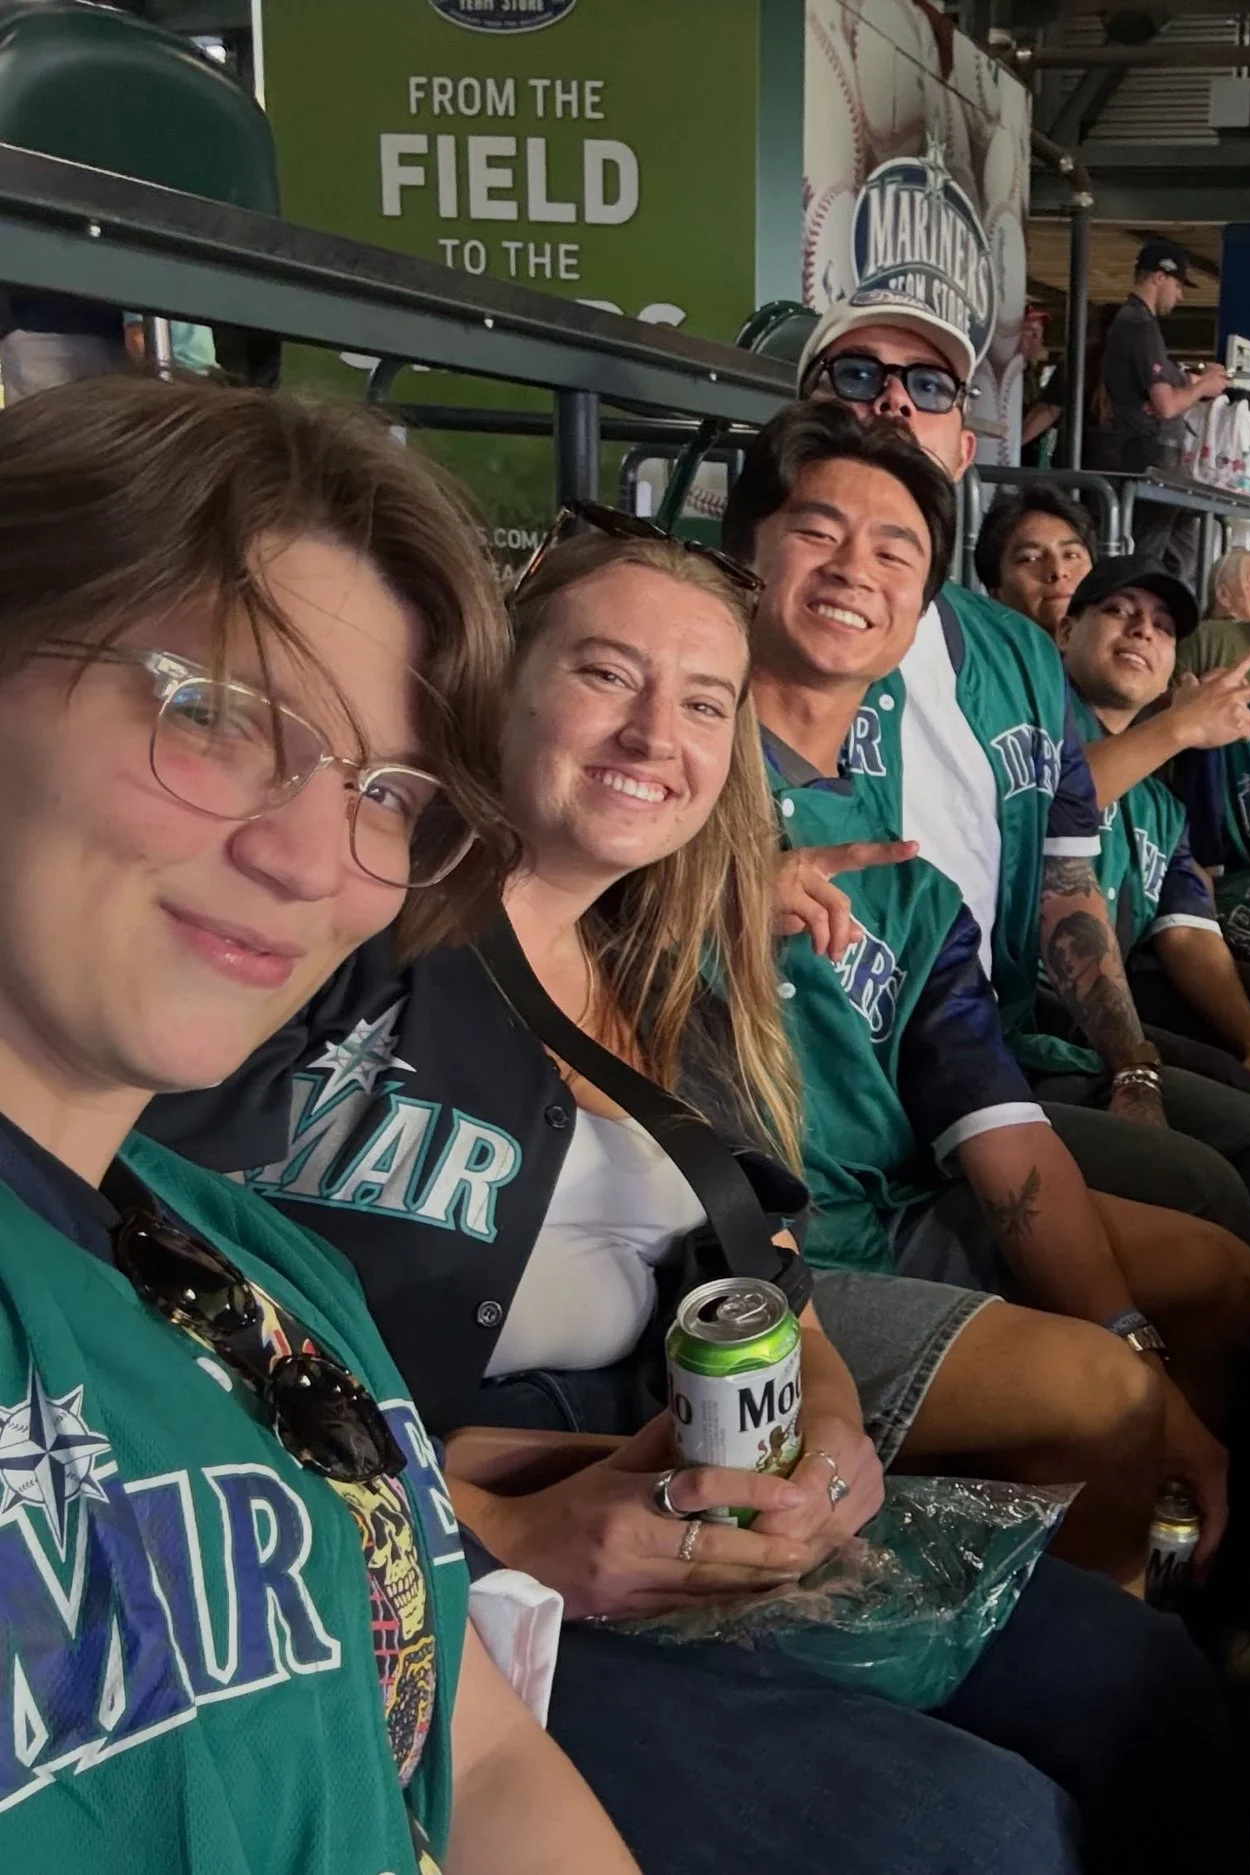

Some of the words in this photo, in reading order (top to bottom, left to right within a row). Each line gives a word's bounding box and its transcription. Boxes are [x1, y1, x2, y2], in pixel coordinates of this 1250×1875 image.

[408, 76, 516, 117] FROM
[528, 79, 605, 119] THE
[379, 133, 639, 225] FIELD
[438, 239, 487, 275] TO
[502, 241, 581, 280] THE
[864, 180, 988, 322] MARINERS
